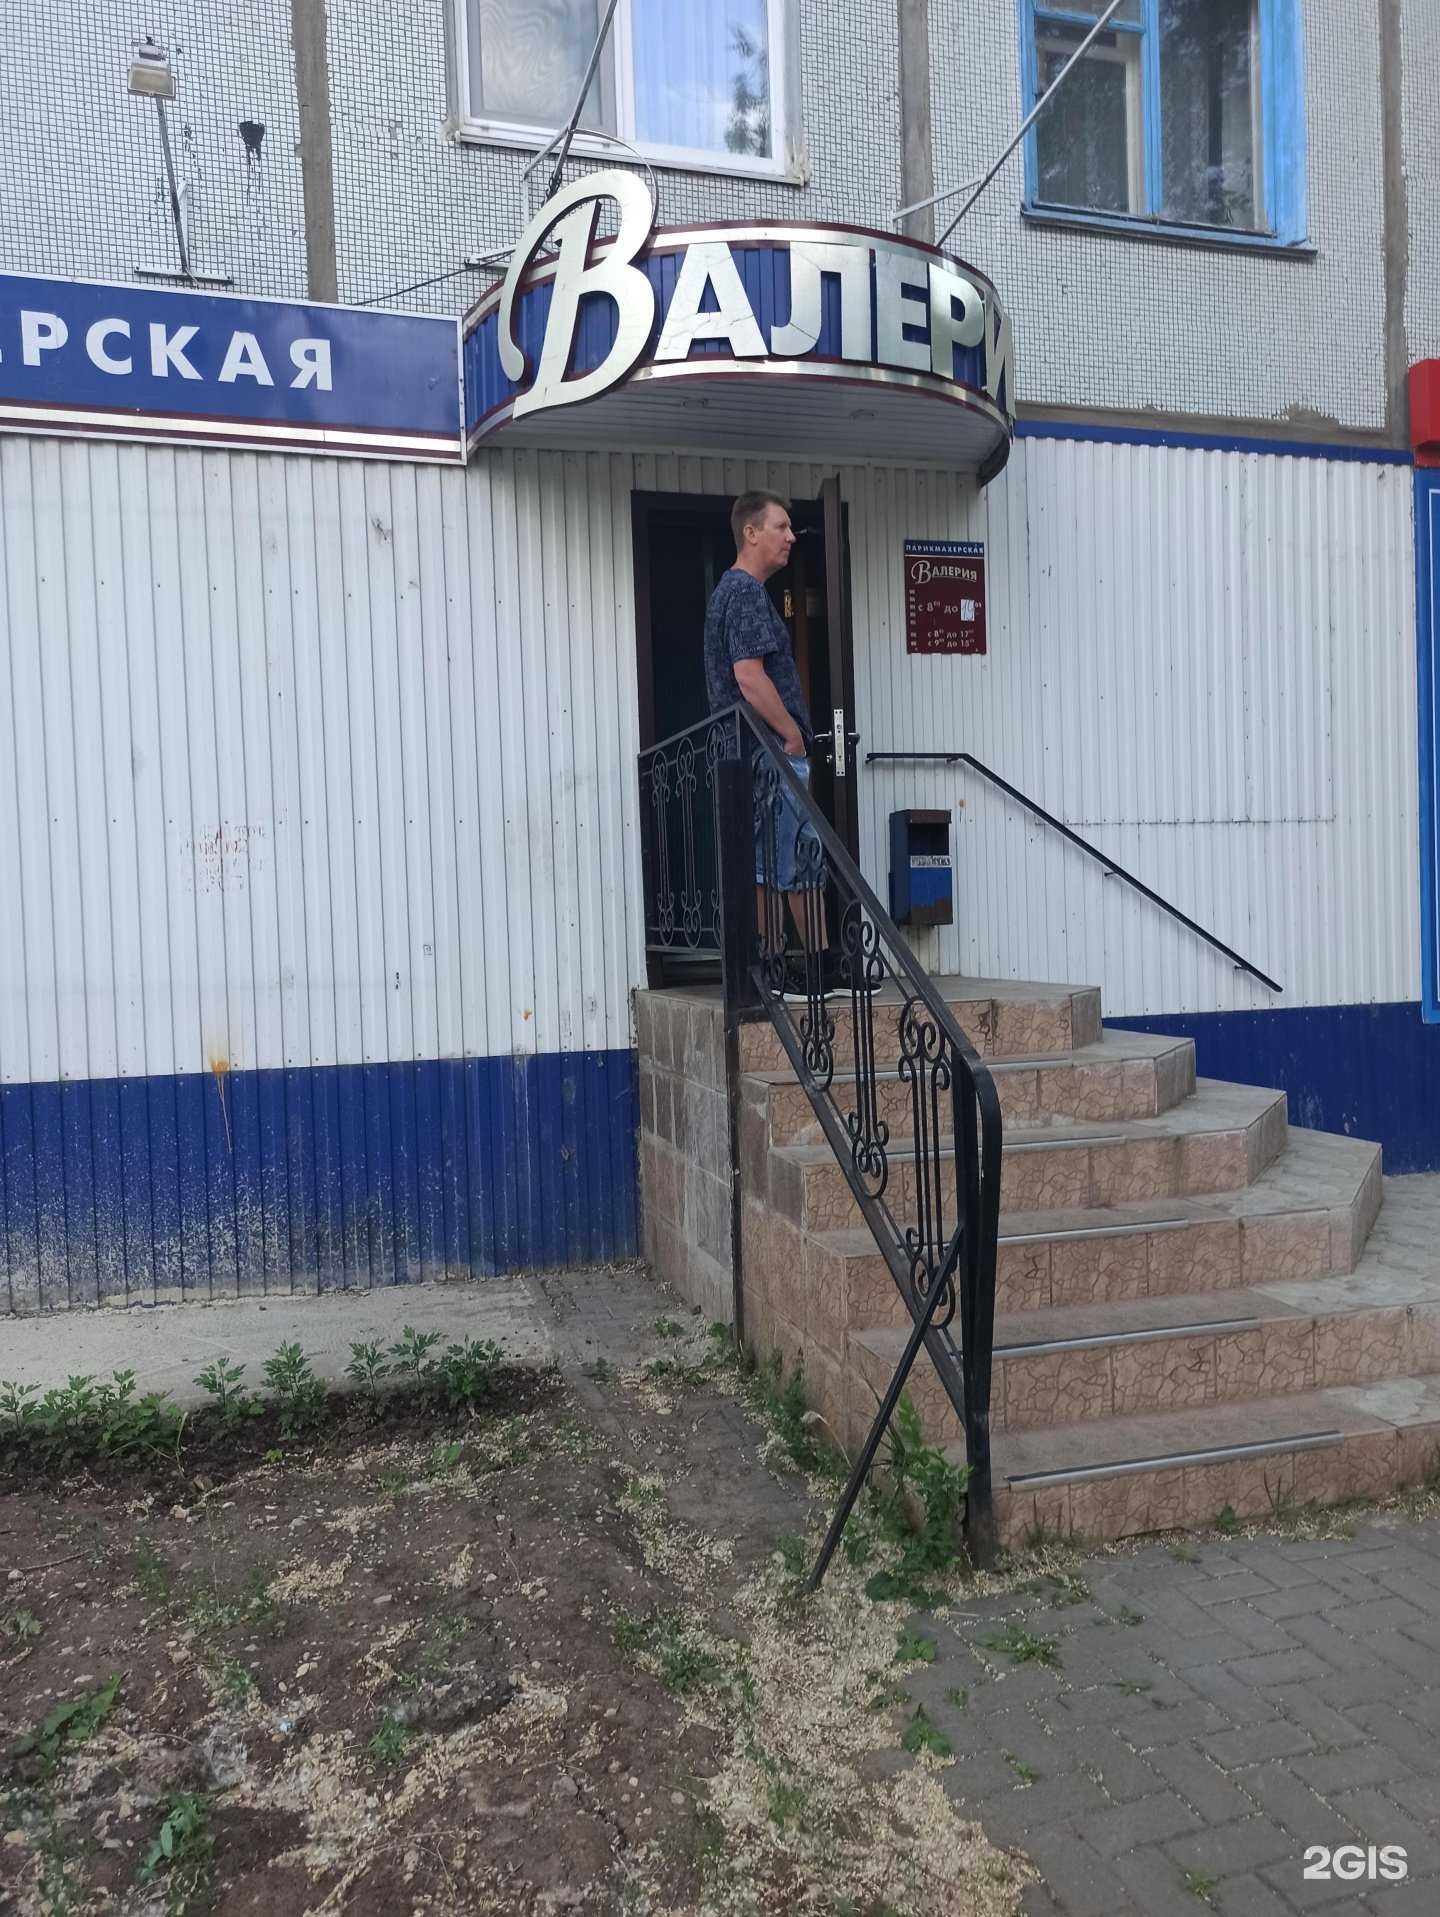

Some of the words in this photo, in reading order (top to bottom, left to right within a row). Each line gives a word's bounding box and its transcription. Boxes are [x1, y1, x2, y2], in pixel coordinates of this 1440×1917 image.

[0, 310, 334, 392] РСКАЯ
[906, 544, 984, 554] ПАРИКМАХЕРСКАЯ
[911, 560, 977, 583] ВАЛЕРИЯ
[944, 605, 959, 614] до
